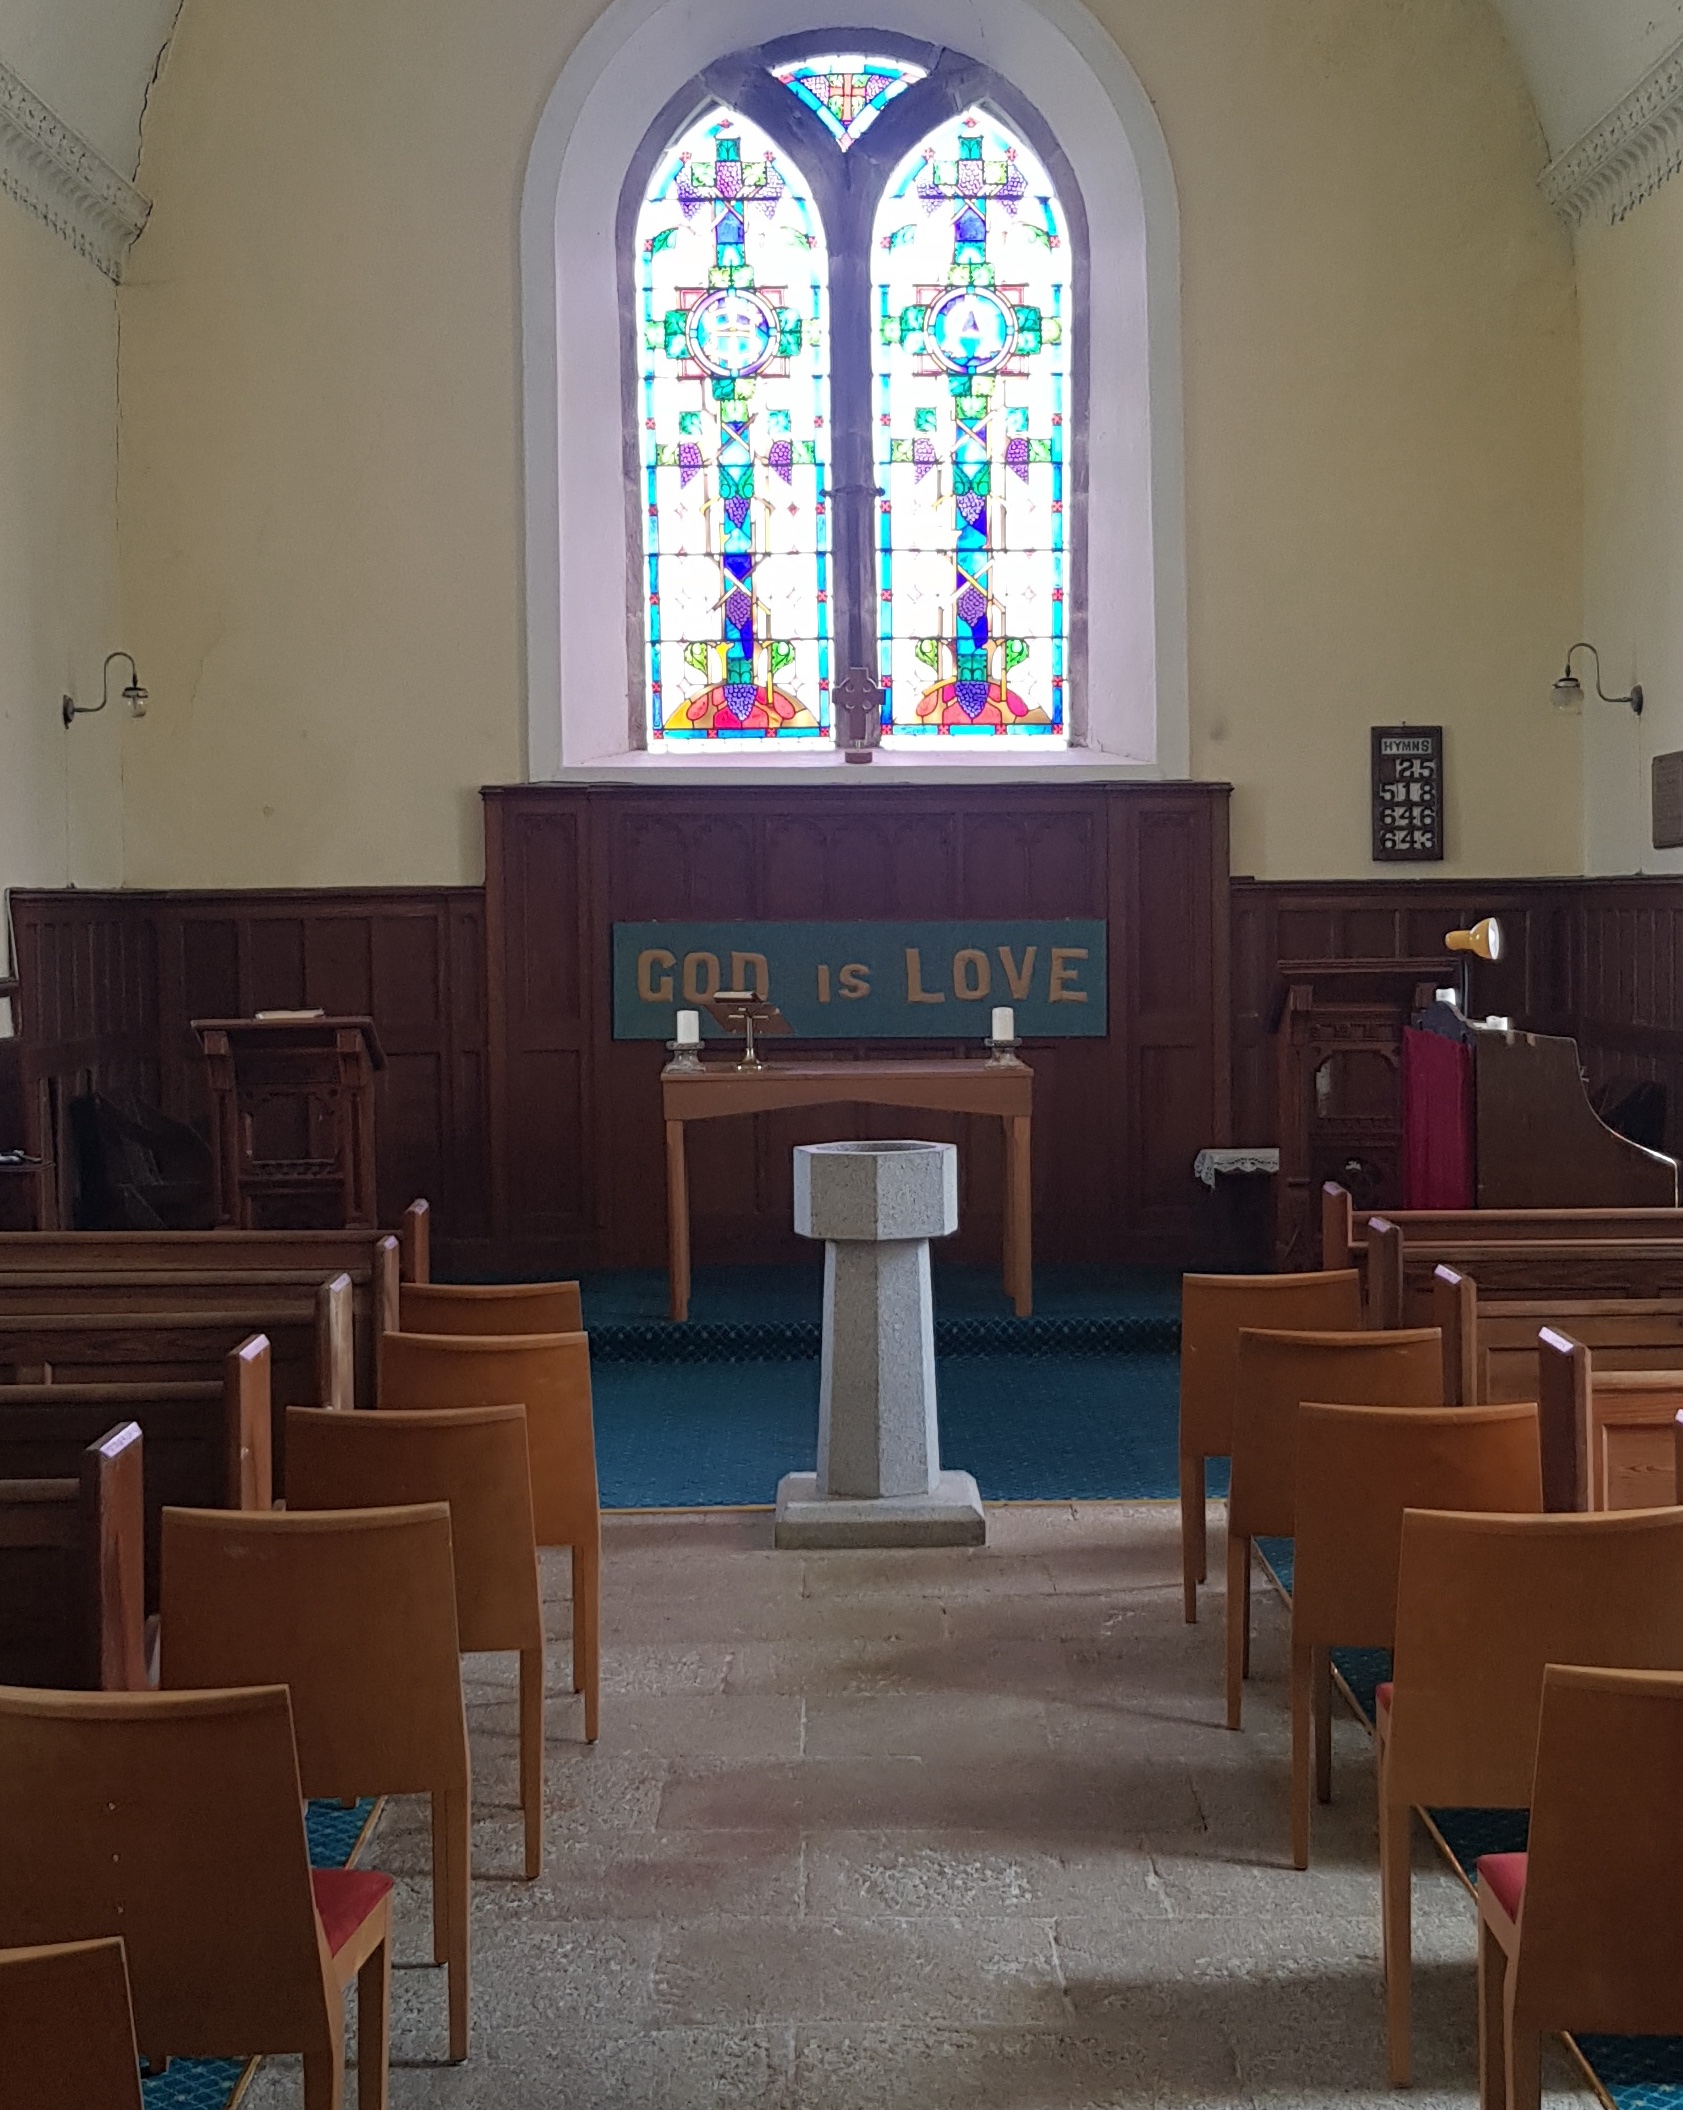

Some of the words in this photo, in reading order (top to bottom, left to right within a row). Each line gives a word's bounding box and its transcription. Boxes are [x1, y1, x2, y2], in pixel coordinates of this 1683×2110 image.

[1383, 740, 1430, 752] HYMNS
[1398, 759, 1435, 779] 25
[1380, 782, 1435, 803] 518
[1380, 806, 1435, 827] 646
[1380, 830, 1435, 850] 643
[637, 948, 771, 1005] GOD
[817, 963, 871, 1003] IS
[905, 946, 1089, 1004] LOVE
